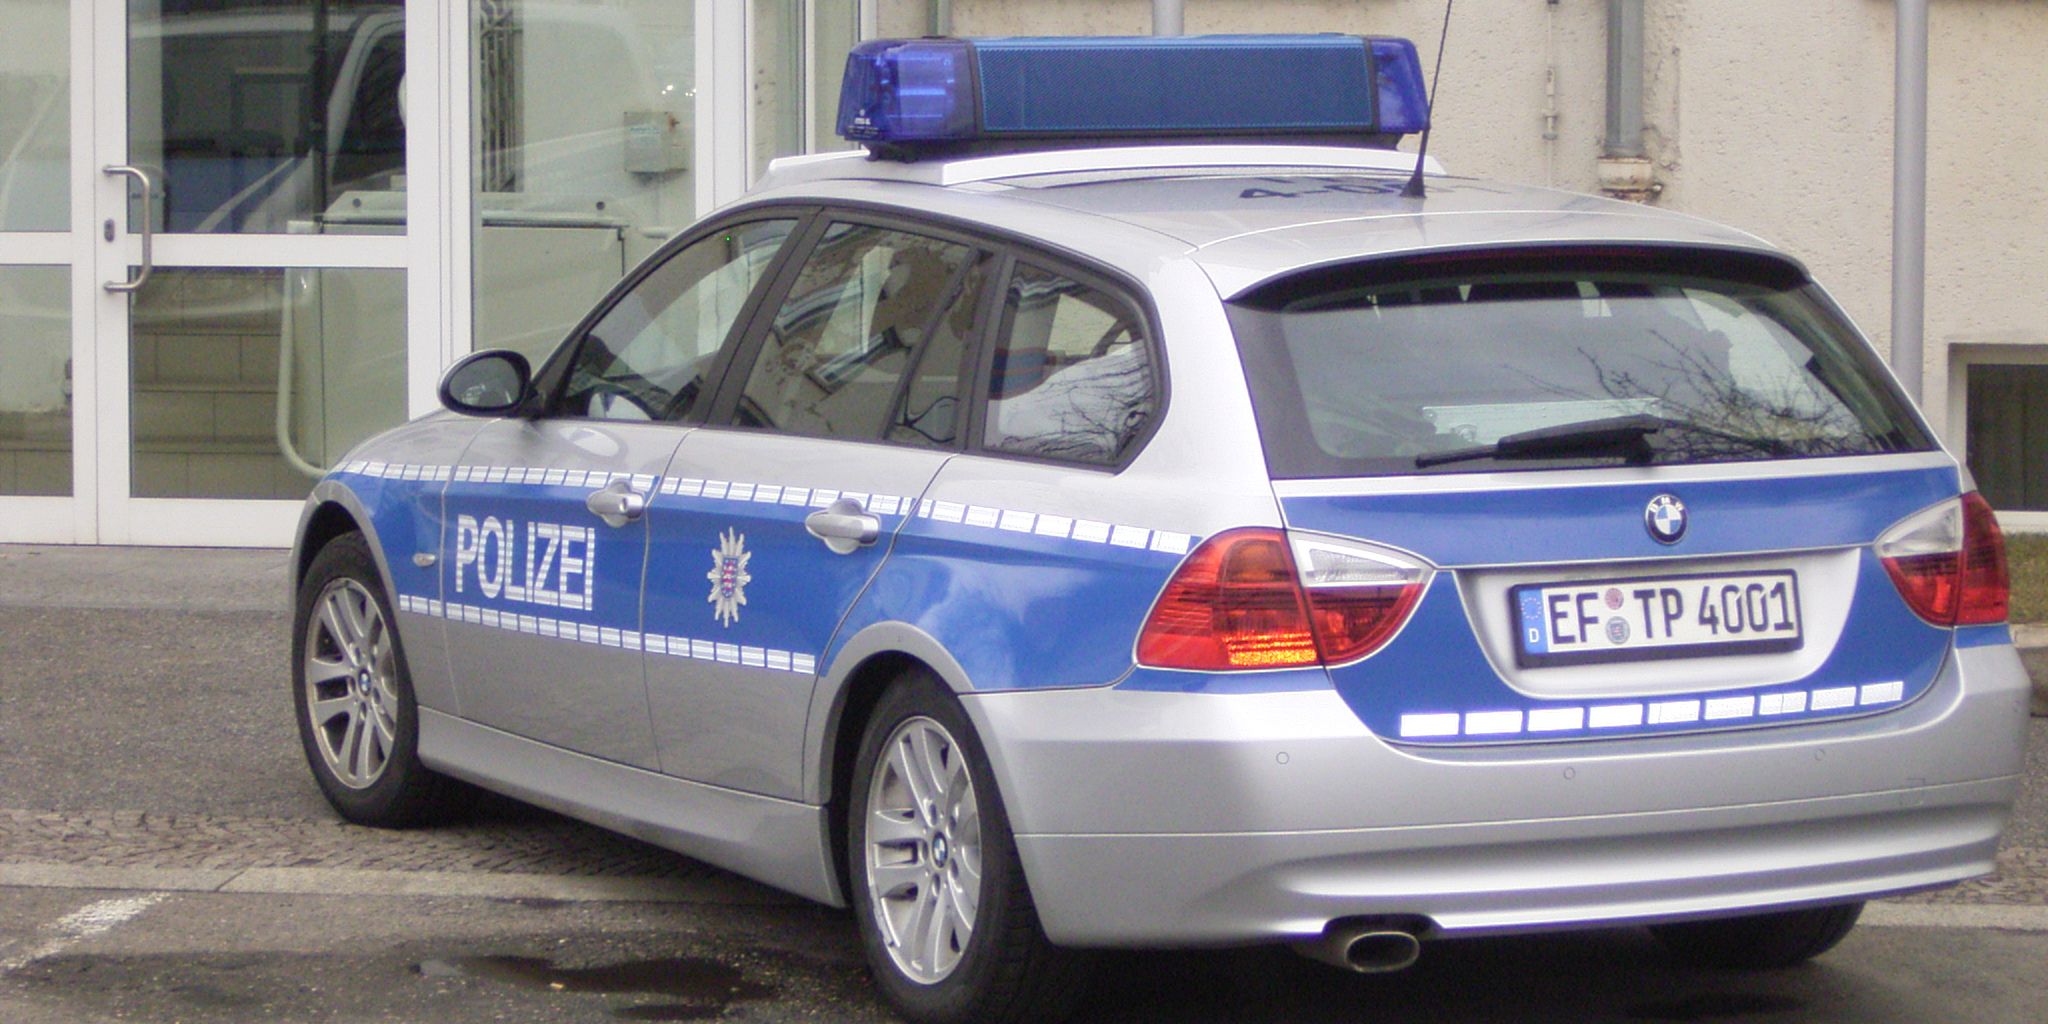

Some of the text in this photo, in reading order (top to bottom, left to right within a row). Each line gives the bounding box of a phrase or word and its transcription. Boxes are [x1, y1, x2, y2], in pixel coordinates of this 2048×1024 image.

[1650, 496, 1684, 512] BMW
[456, 514, 595, 611] POLIZEI
[1549, 582, 1794, 645] EF TP 4001
[1529, 628, 1540, 643] D
